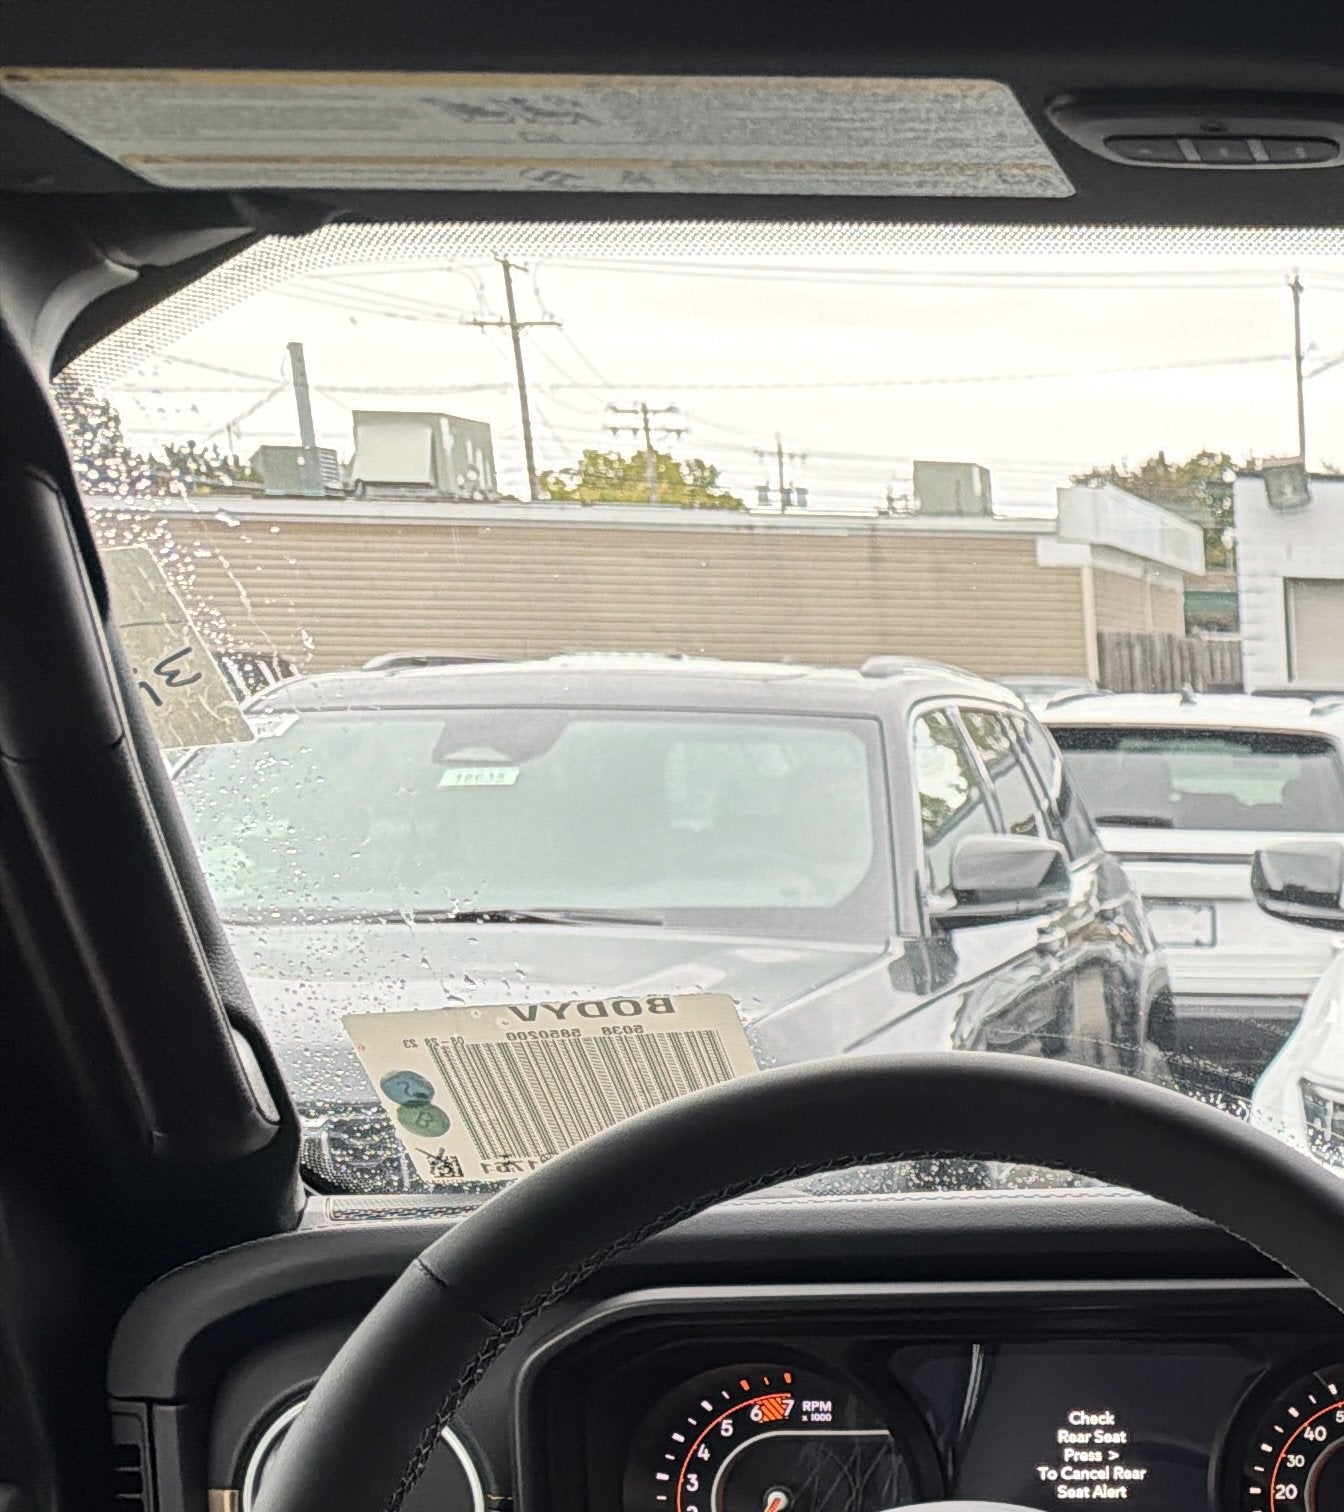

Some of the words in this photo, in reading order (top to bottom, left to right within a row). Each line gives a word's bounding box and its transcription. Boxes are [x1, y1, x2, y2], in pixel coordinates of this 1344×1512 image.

[750, 1404, 763, 1422] 6
[781, 1399, 795, 1417] 7
[802, 1400, 832, 1412] RPM
[1068, 1410, 1115, 1426] Check
[720, 1419, 734, 1437] 5
[1057, 1428, 1092, 1444] Rear
[1093, 1429, 1127, 1444] Seat
[1303, 1425, 1327, 1442] 40
[697, 1443, 711, 1461] 4
[1063, 1447, 1103, 1462] Press
[1286, 1454, 1306, 1468] 30
[1036, 1466, 1059, 1481] To
[1060, 1464, 1110, 1481] Cancel
[1113, 1465, 1147, 1481] Rear
[686, 1473, 699, 1492] 3
[1056, 1484, 1091, 1499] Seat
[1091, 1483, 1128, 1499] Alert
[1274, 1483, 1299, 1500] 20
